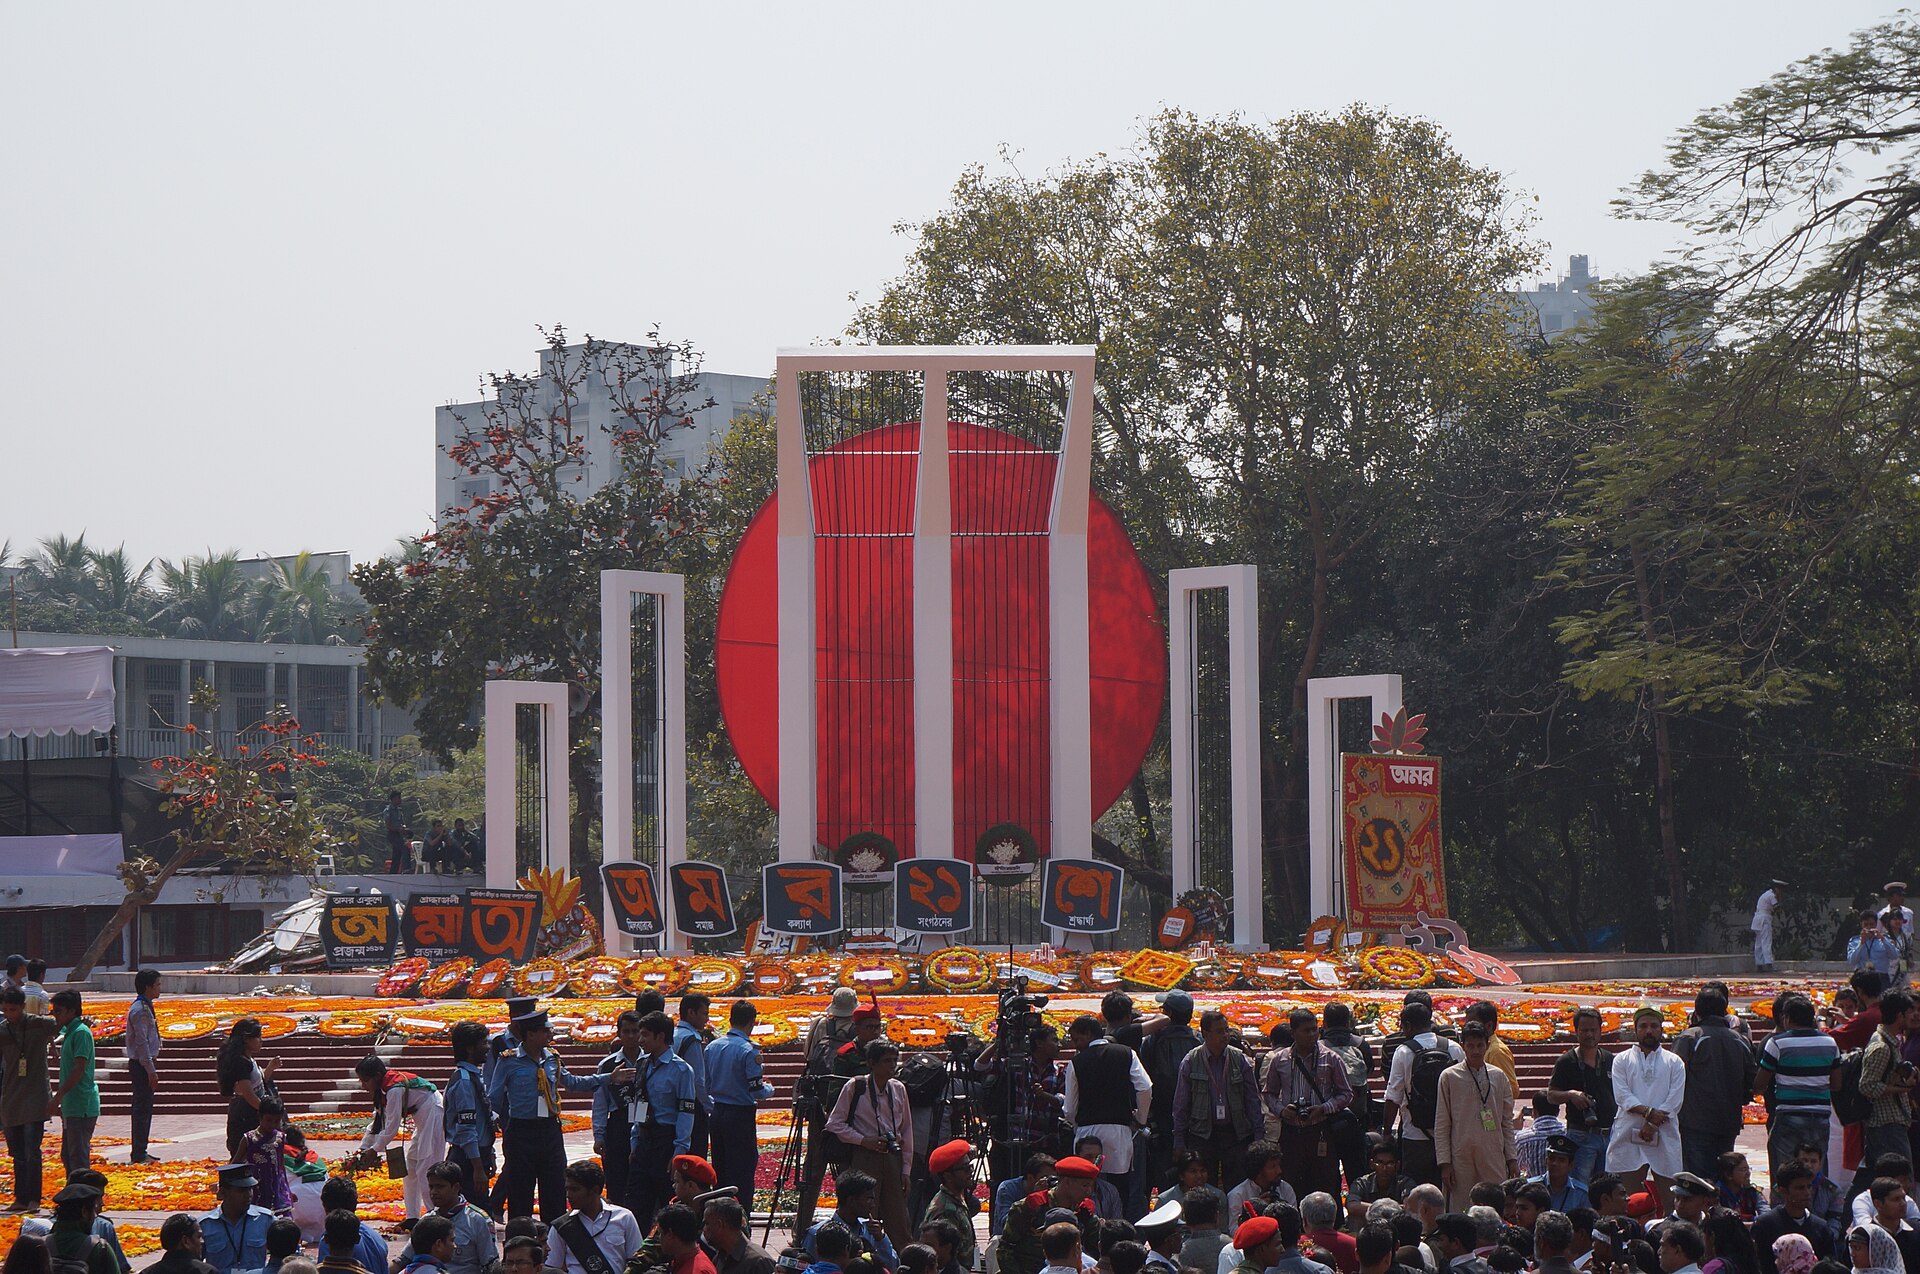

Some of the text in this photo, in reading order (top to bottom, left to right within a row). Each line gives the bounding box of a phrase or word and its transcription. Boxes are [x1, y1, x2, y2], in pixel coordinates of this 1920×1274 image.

[1389, 765, 1434, 787] অমর
[1361, 823, 1401, 872] ২১
[608, 869, 657, 920] অ
[679, 869, 726, 923] ম
[777, 868, 833, 919] র
[909, 866, 962, 914] ২১
[1055, 864, 1114, 920] শে
[331, 907, 390, 944] অ
[471, 899, 536, 960] অ
[695, 921, 715, 931] সমাজ
[787, 919, 812, 930] কল্যাণ
[917, 914, 953, 927] সংগঠনের
[332, 946, 366, 958] প্রজন্ম
[413, 948, 443, 958] প্রজন্ম
